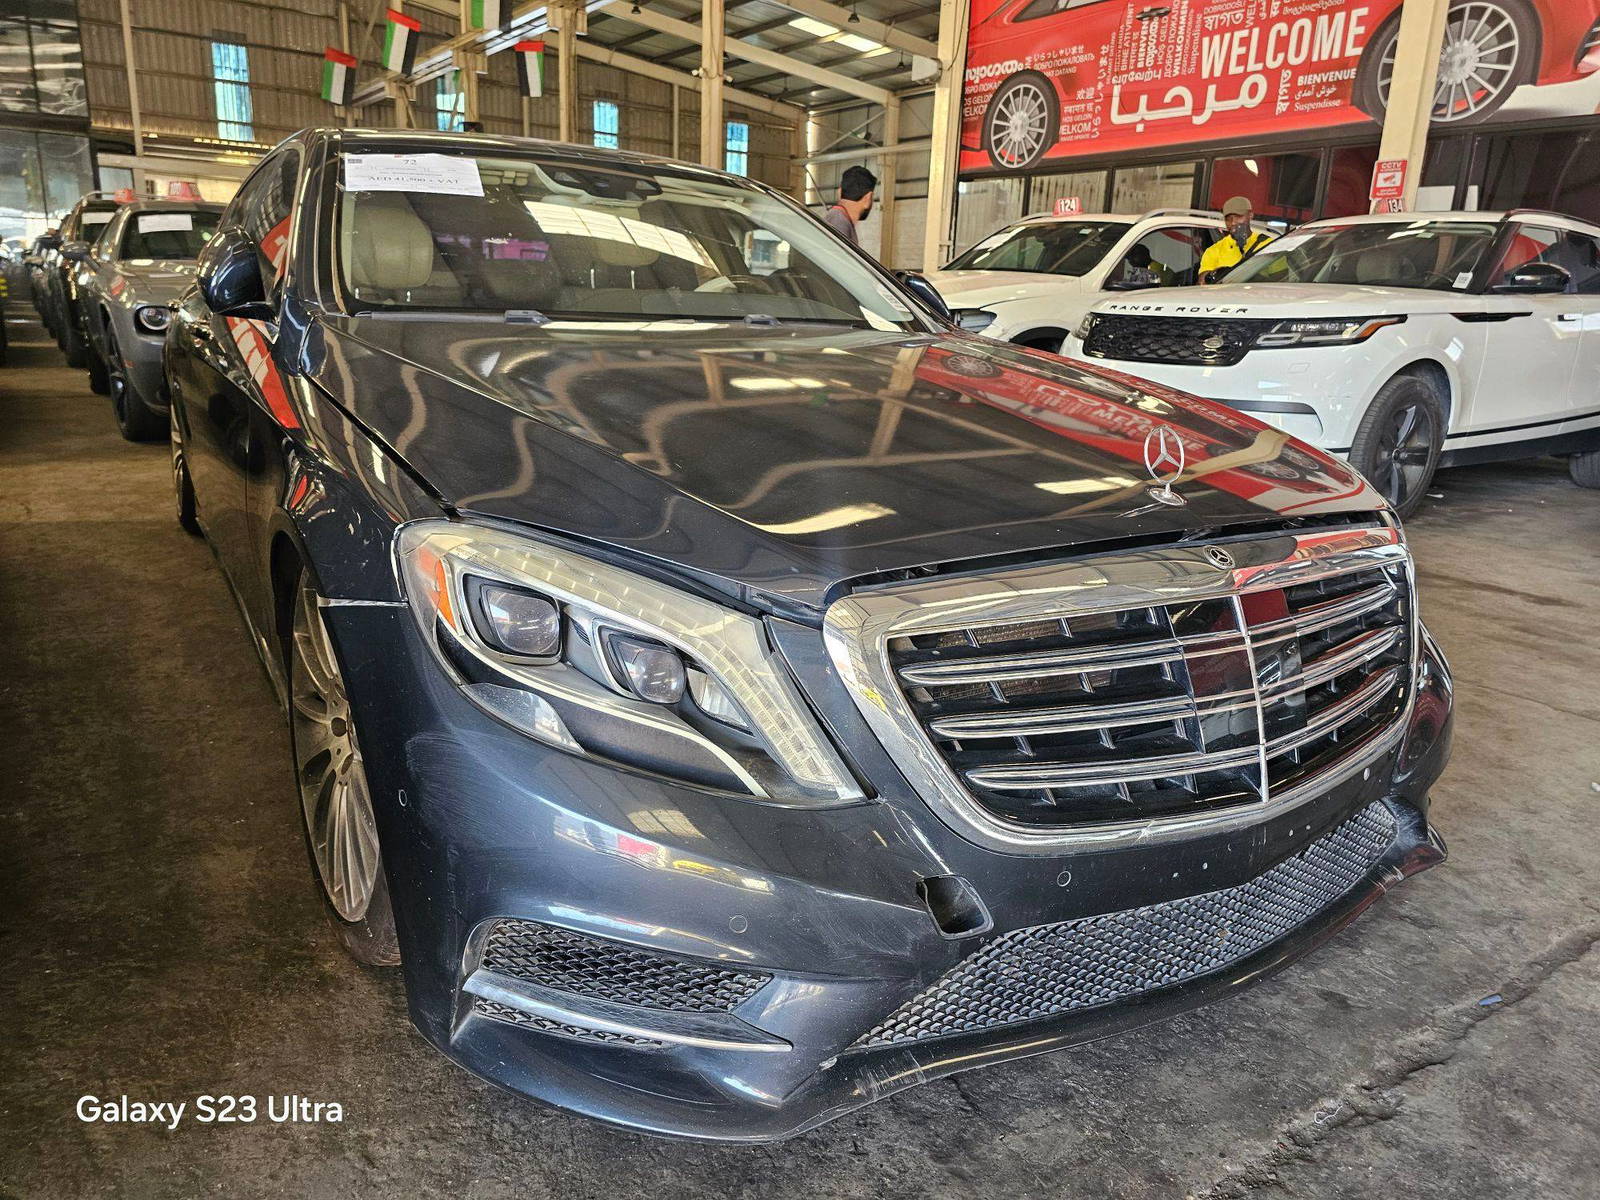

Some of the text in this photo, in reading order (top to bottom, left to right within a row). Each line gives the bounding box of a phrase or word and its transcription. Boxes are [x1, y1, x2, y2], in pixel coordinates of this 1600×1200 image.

[1136, 6, 1152, 69] BIENVENE
[1160, 15, 1169, 42] GELD
[1200, 7, 1369, 80] WELCOME
[1297, 68, 1358, 87] BIENVENUE
[1110, 73, 1268, 133] مرحبا
[1059, 121, 1092, 136] ELKOM
[1109, 304, 1249, 314] RANGE ROVER
